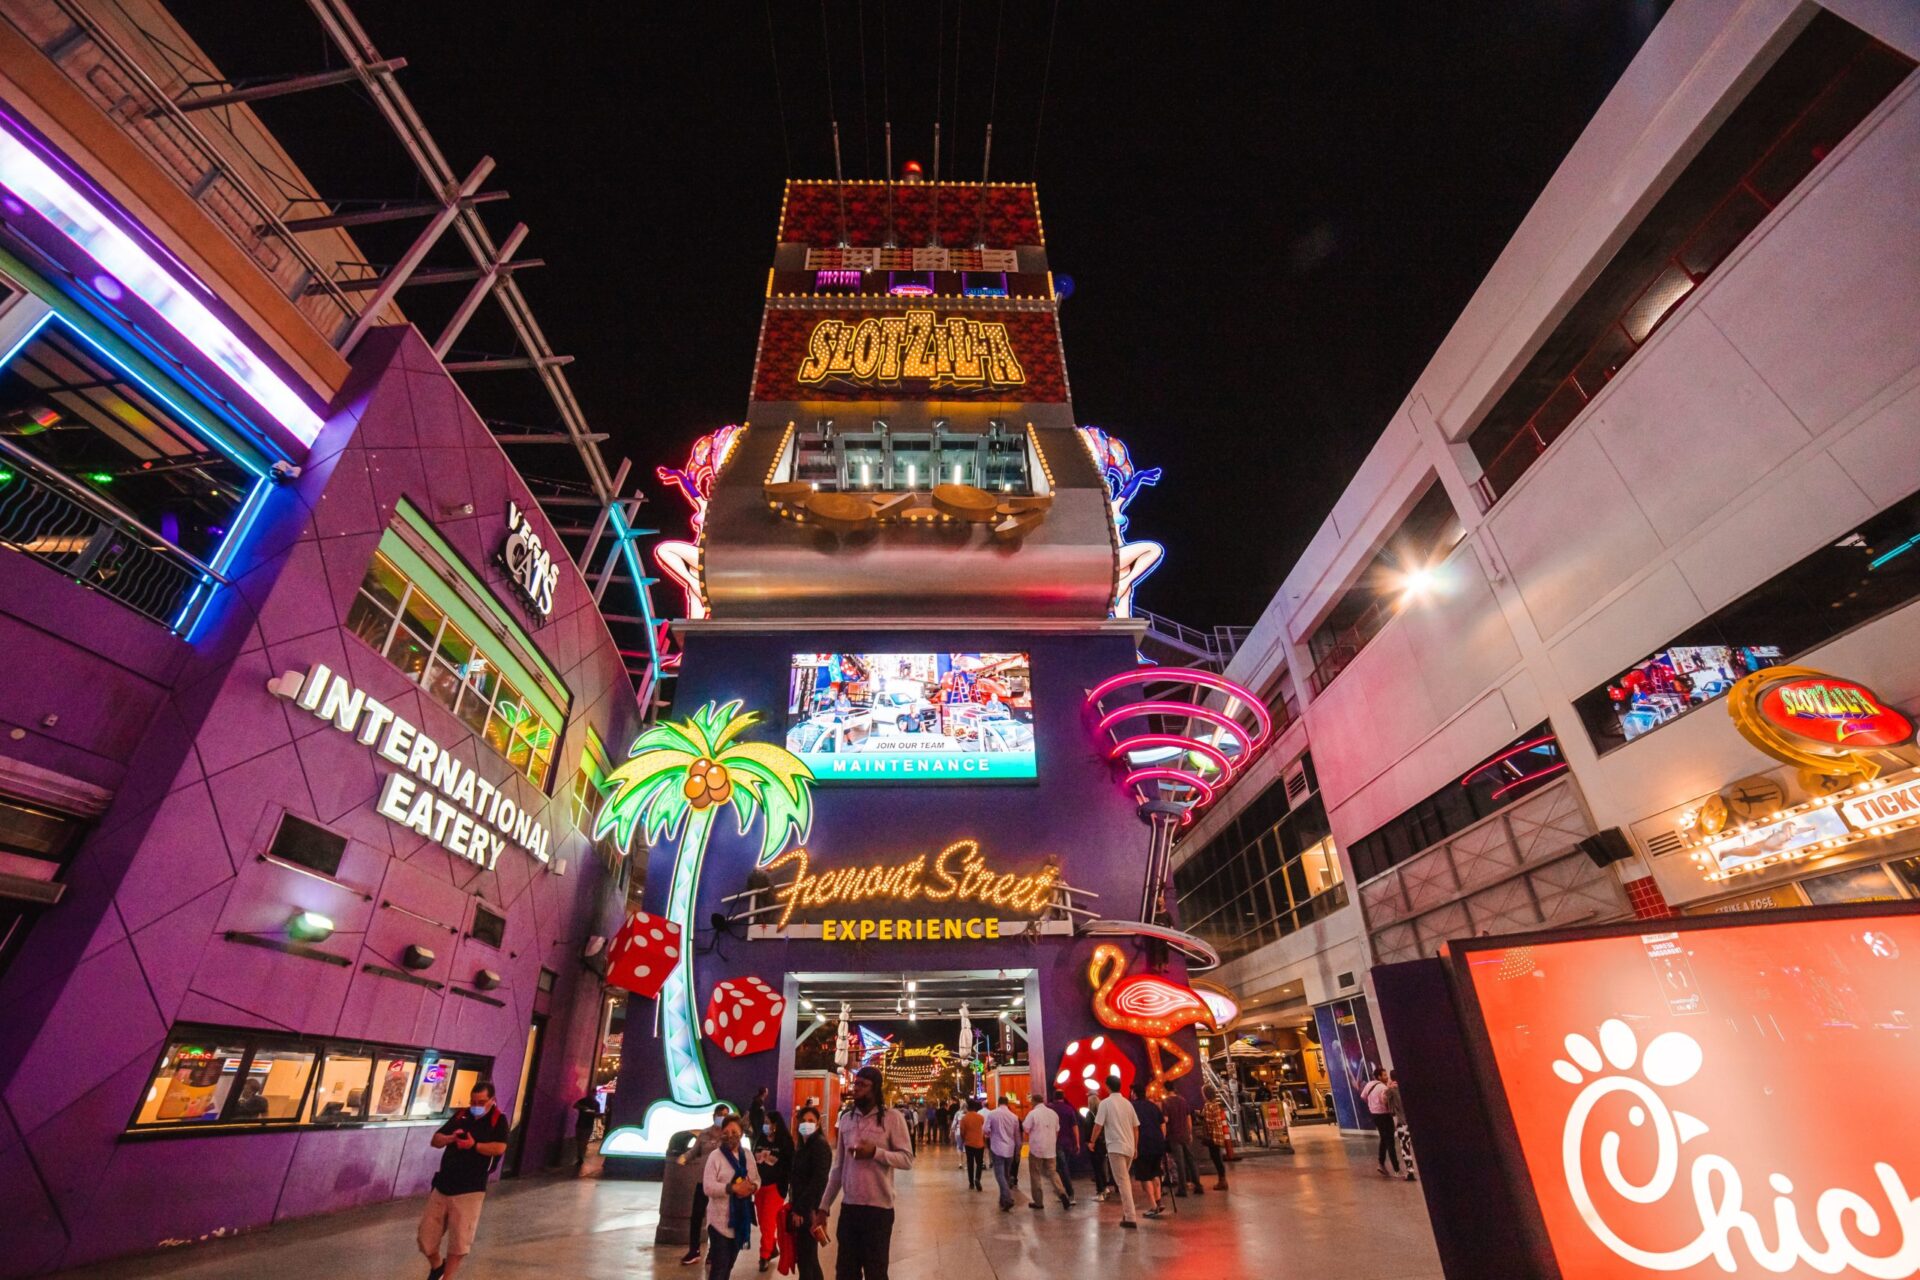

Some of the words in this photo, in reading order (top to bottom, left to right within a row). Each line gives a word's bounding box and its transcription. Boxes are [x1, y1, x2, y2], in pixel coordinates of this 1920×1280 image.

[798, 311, 1025, 384] SLOTZILLA
[508, 501, 560, 594] VEGAS
[1779, 683, 1881, 716] SLOTZILLA
[298, 663, 551, 864] INTERNATIONAL
[833, 758, 990, 772] MAINTENANCE
[377, 772, 506, 871] EATERY
[767, 848, 926, 933] Fremont
[924, 839, 1060, 912] Street
[822, 917, 1000, 941] EXPERIENCE
